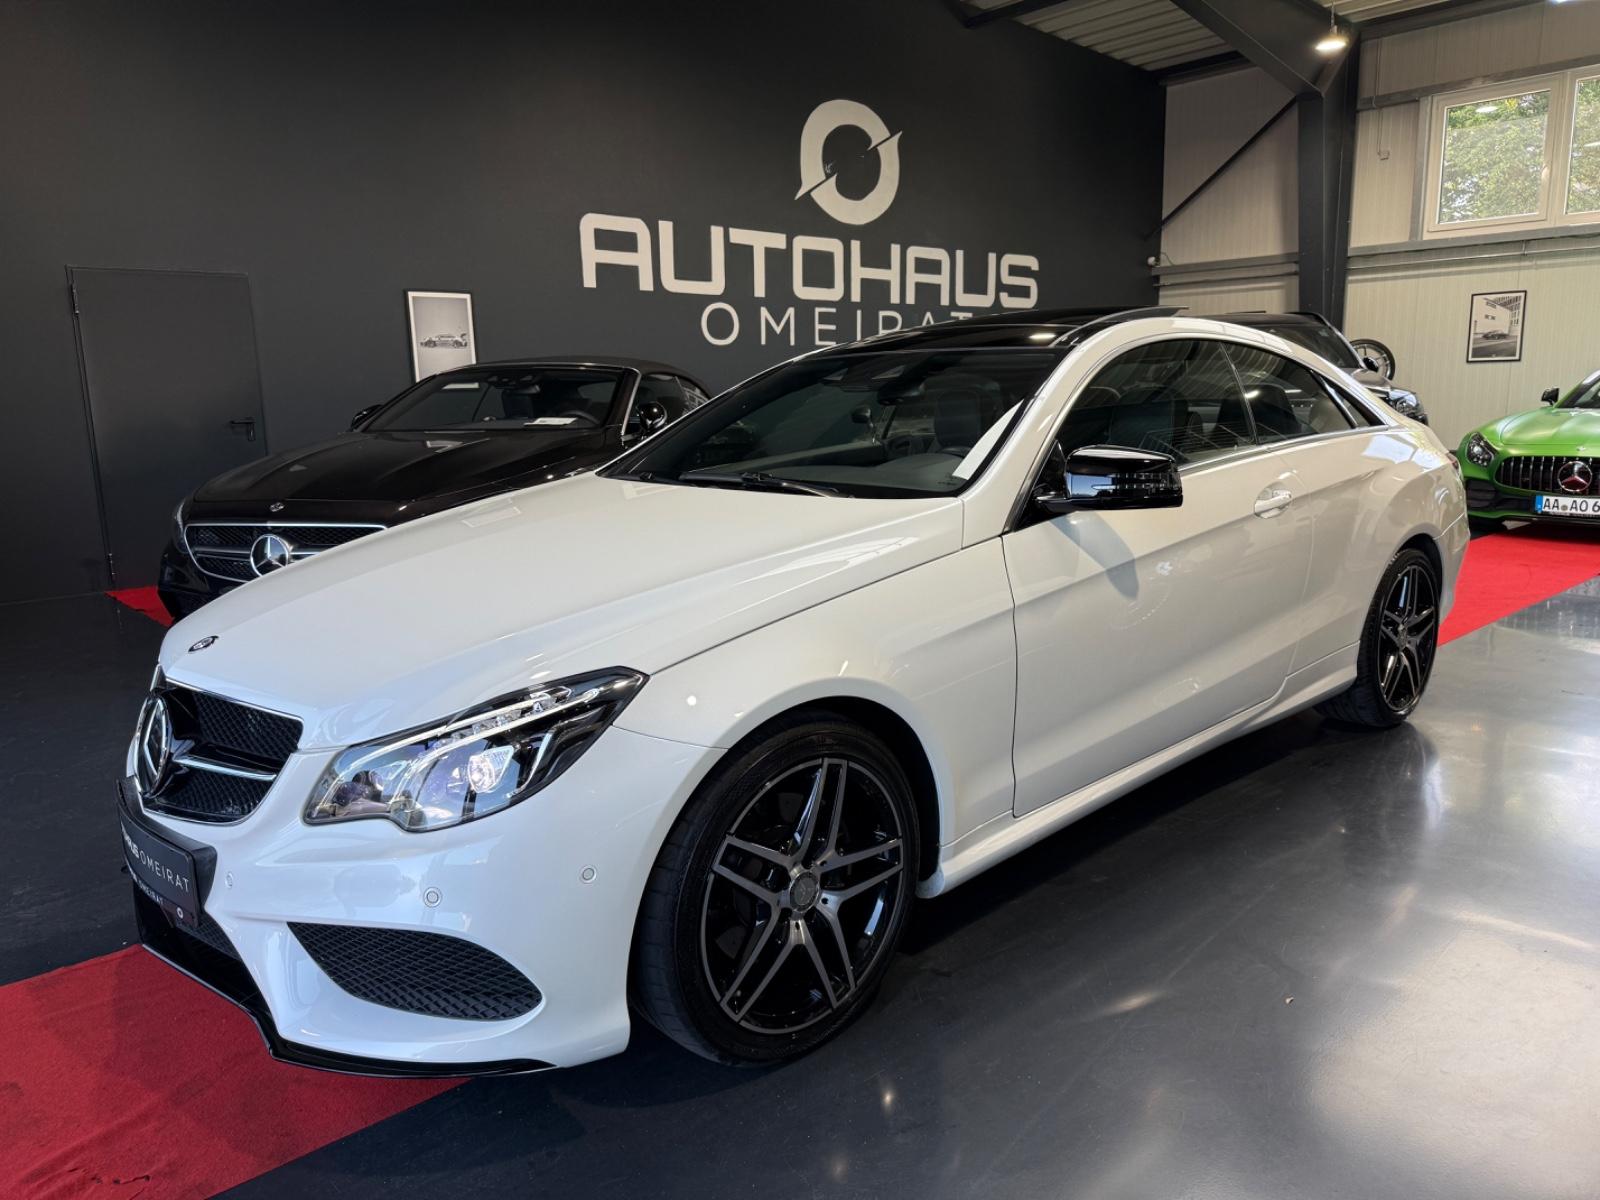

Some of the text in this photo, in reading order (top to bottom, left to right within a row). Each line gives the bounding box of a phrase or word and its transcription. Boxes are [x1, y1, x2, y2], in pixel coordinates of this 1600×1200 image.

[579, 212, 1040, 309] AUTOHAUS
[1543, 498, 1560, 511] AA
[1569, 499, 1589, 512] AO
[139, 850, 190, 893] OMEIRAT
